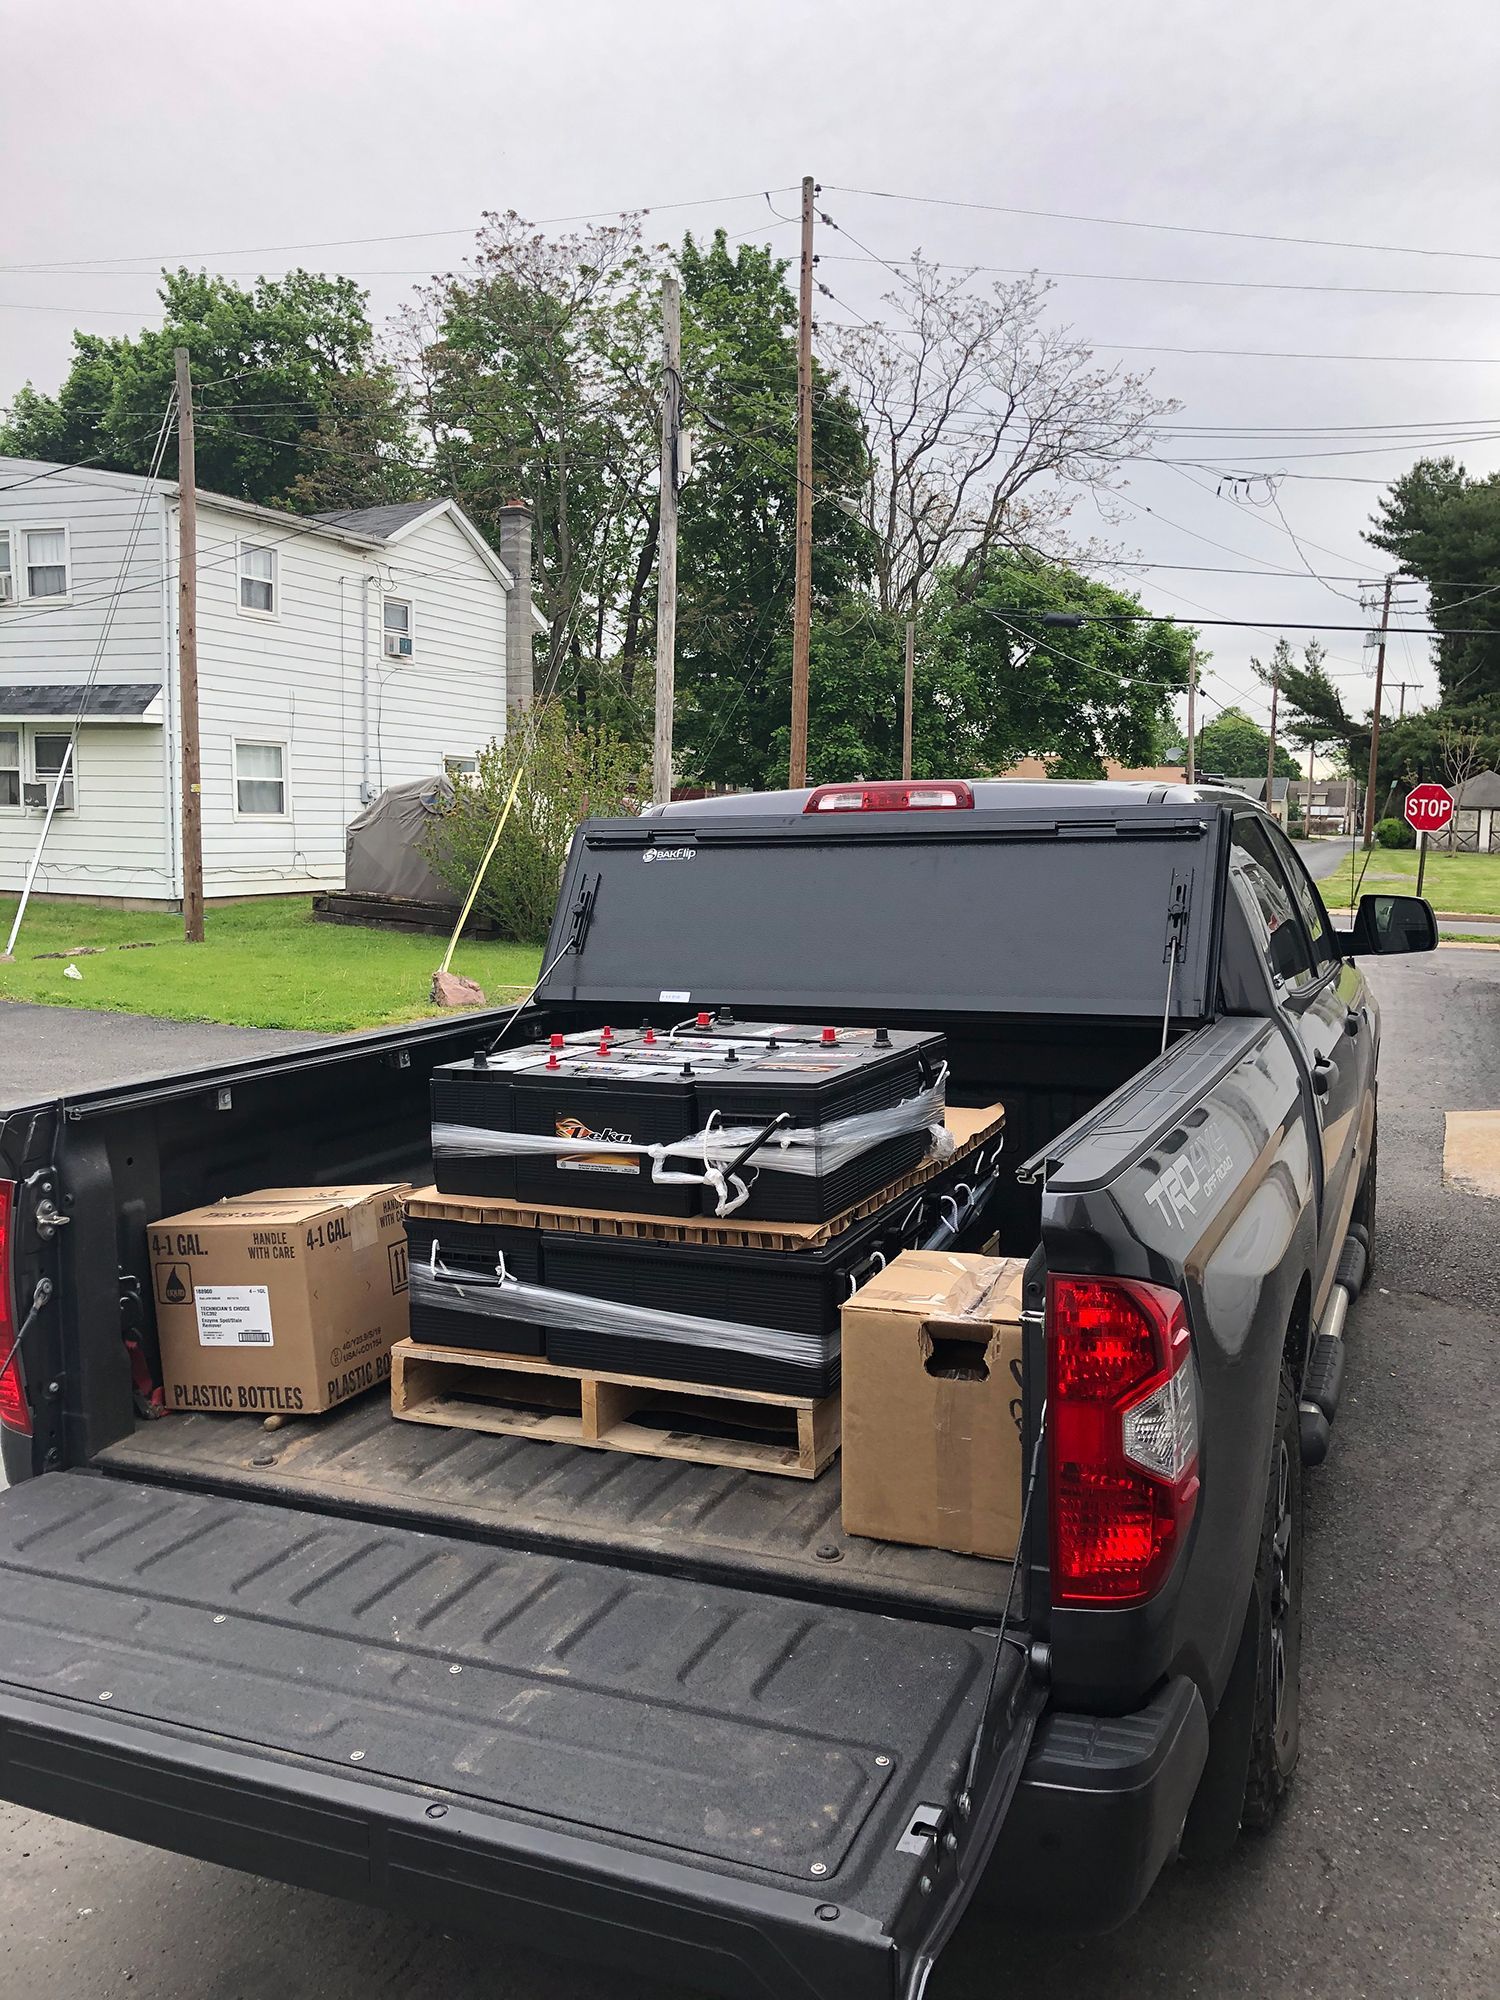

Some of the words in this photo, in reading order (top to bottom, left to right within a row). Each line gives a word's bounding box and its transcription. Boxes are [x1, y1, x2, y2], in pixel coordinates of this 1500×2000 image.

[1407, 798, 1451, 818] STOP
[656, 848, 697, 861] BAKFlip
[1202, 1173, 1217, 1198] OFF
[1214, 1155, 1234, 1183] ROAD
[1144, 1153, 1200, 1230] TRD
[152, 1235, 173, 1256] 4-1
[176, 1233, 208, 1256] GAL.
[252, 1232, 287, 1245] HANDLE
[306, 1224, 325, 1250] 4-1
[326, 1217, 351, 1244] GAL.
[247, 1246, 270, 1259] WITH
[272, 1246, 296, 1260] CARE
[328, 1361, 373, 1404] PLASTIC
[174, 1384, 233, 1408] PLASTIC
[238, 1385, 303, 1410] BOTTLES
